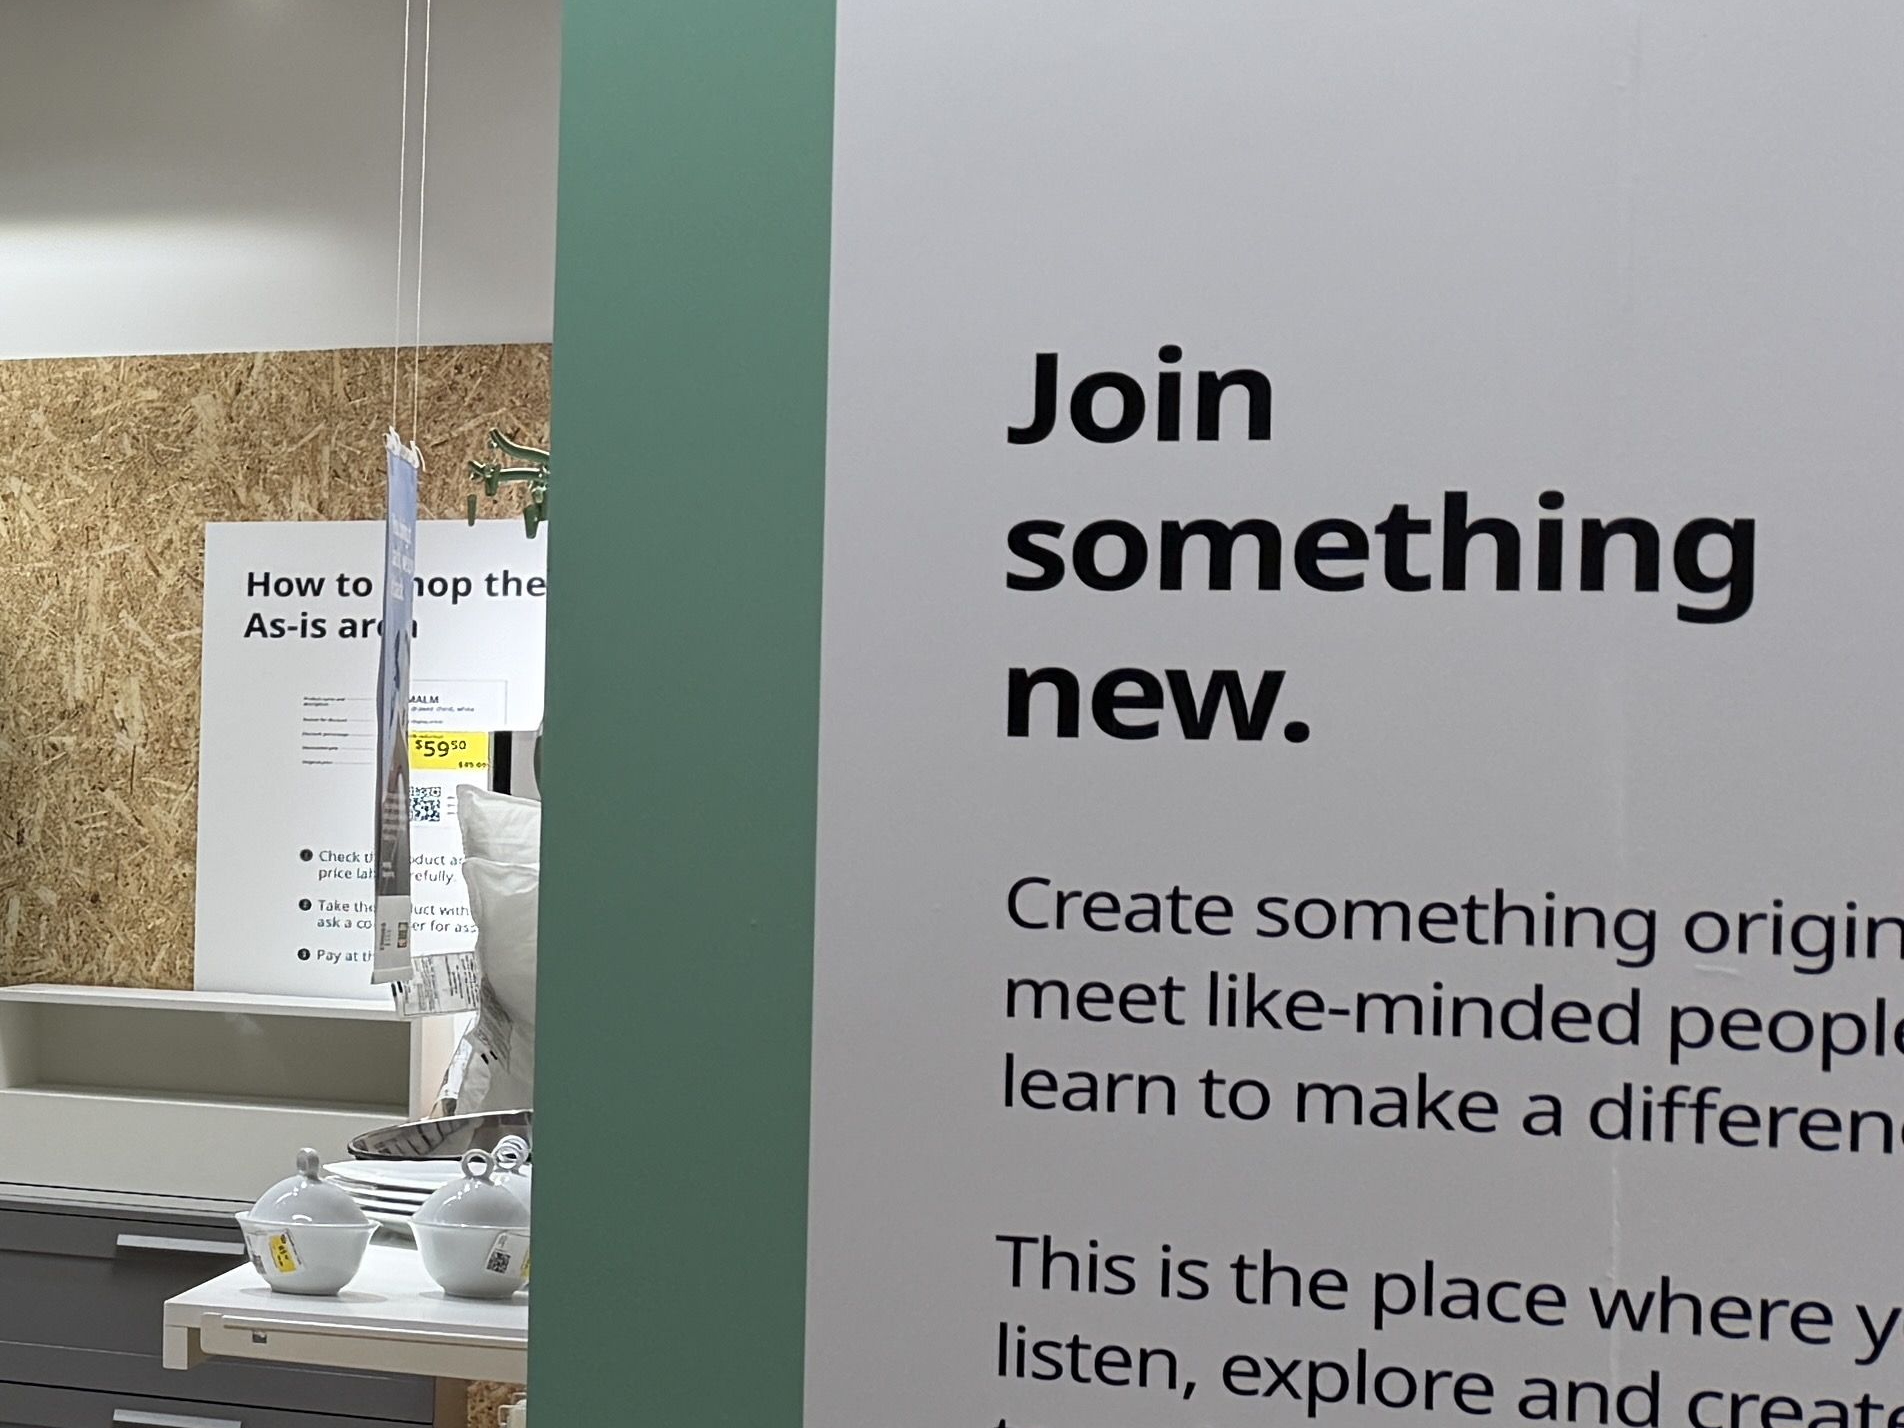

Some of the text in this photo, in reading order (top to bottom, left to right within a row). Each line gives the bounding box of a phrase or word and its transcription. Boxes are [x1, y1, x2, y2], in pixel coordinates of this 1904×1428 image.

[1007, 344, 1272, 445] Join
[247, 569, 546, 605] How to op the
[1006, 490, 1755, 625] something
[243, 611, 418, 639] As-is ar
[1007, 667, 1310, 744] new.
[318, 868, 352, 881] price
[412, 873, 457, 885] efully.
[319, 850, 360, 863] Check
[411, 854, 445, 865] duct
[317, 916, 340, 928] ask
[344, 919, 352, 928] a
[430, 922, 450, 932] for
[318, 900, 349, 912] Take
[1007, 876, 1904, 975] Create something origin
[317, 950, 341, 964] Pay
[345, 951, 358, 961] at
[1006, 970, 1904, 1073] meet like-minded peopl
[1004, 1052, 1904, 1154] learn to make a differen
[995, 1234, 1136, 1297] This
[1160, 1244, 1210, 1302] is
[1229, 1248, 1348, 1311] the
[1374, 1259, 1567, 1331] place
[1589, 1275, 1833, 1345] where
[998, 1321, 1196, 1400] listen,
[1222, 1347, 1494, 1419] explore
[1518, 1370, 1660, 1428] and
